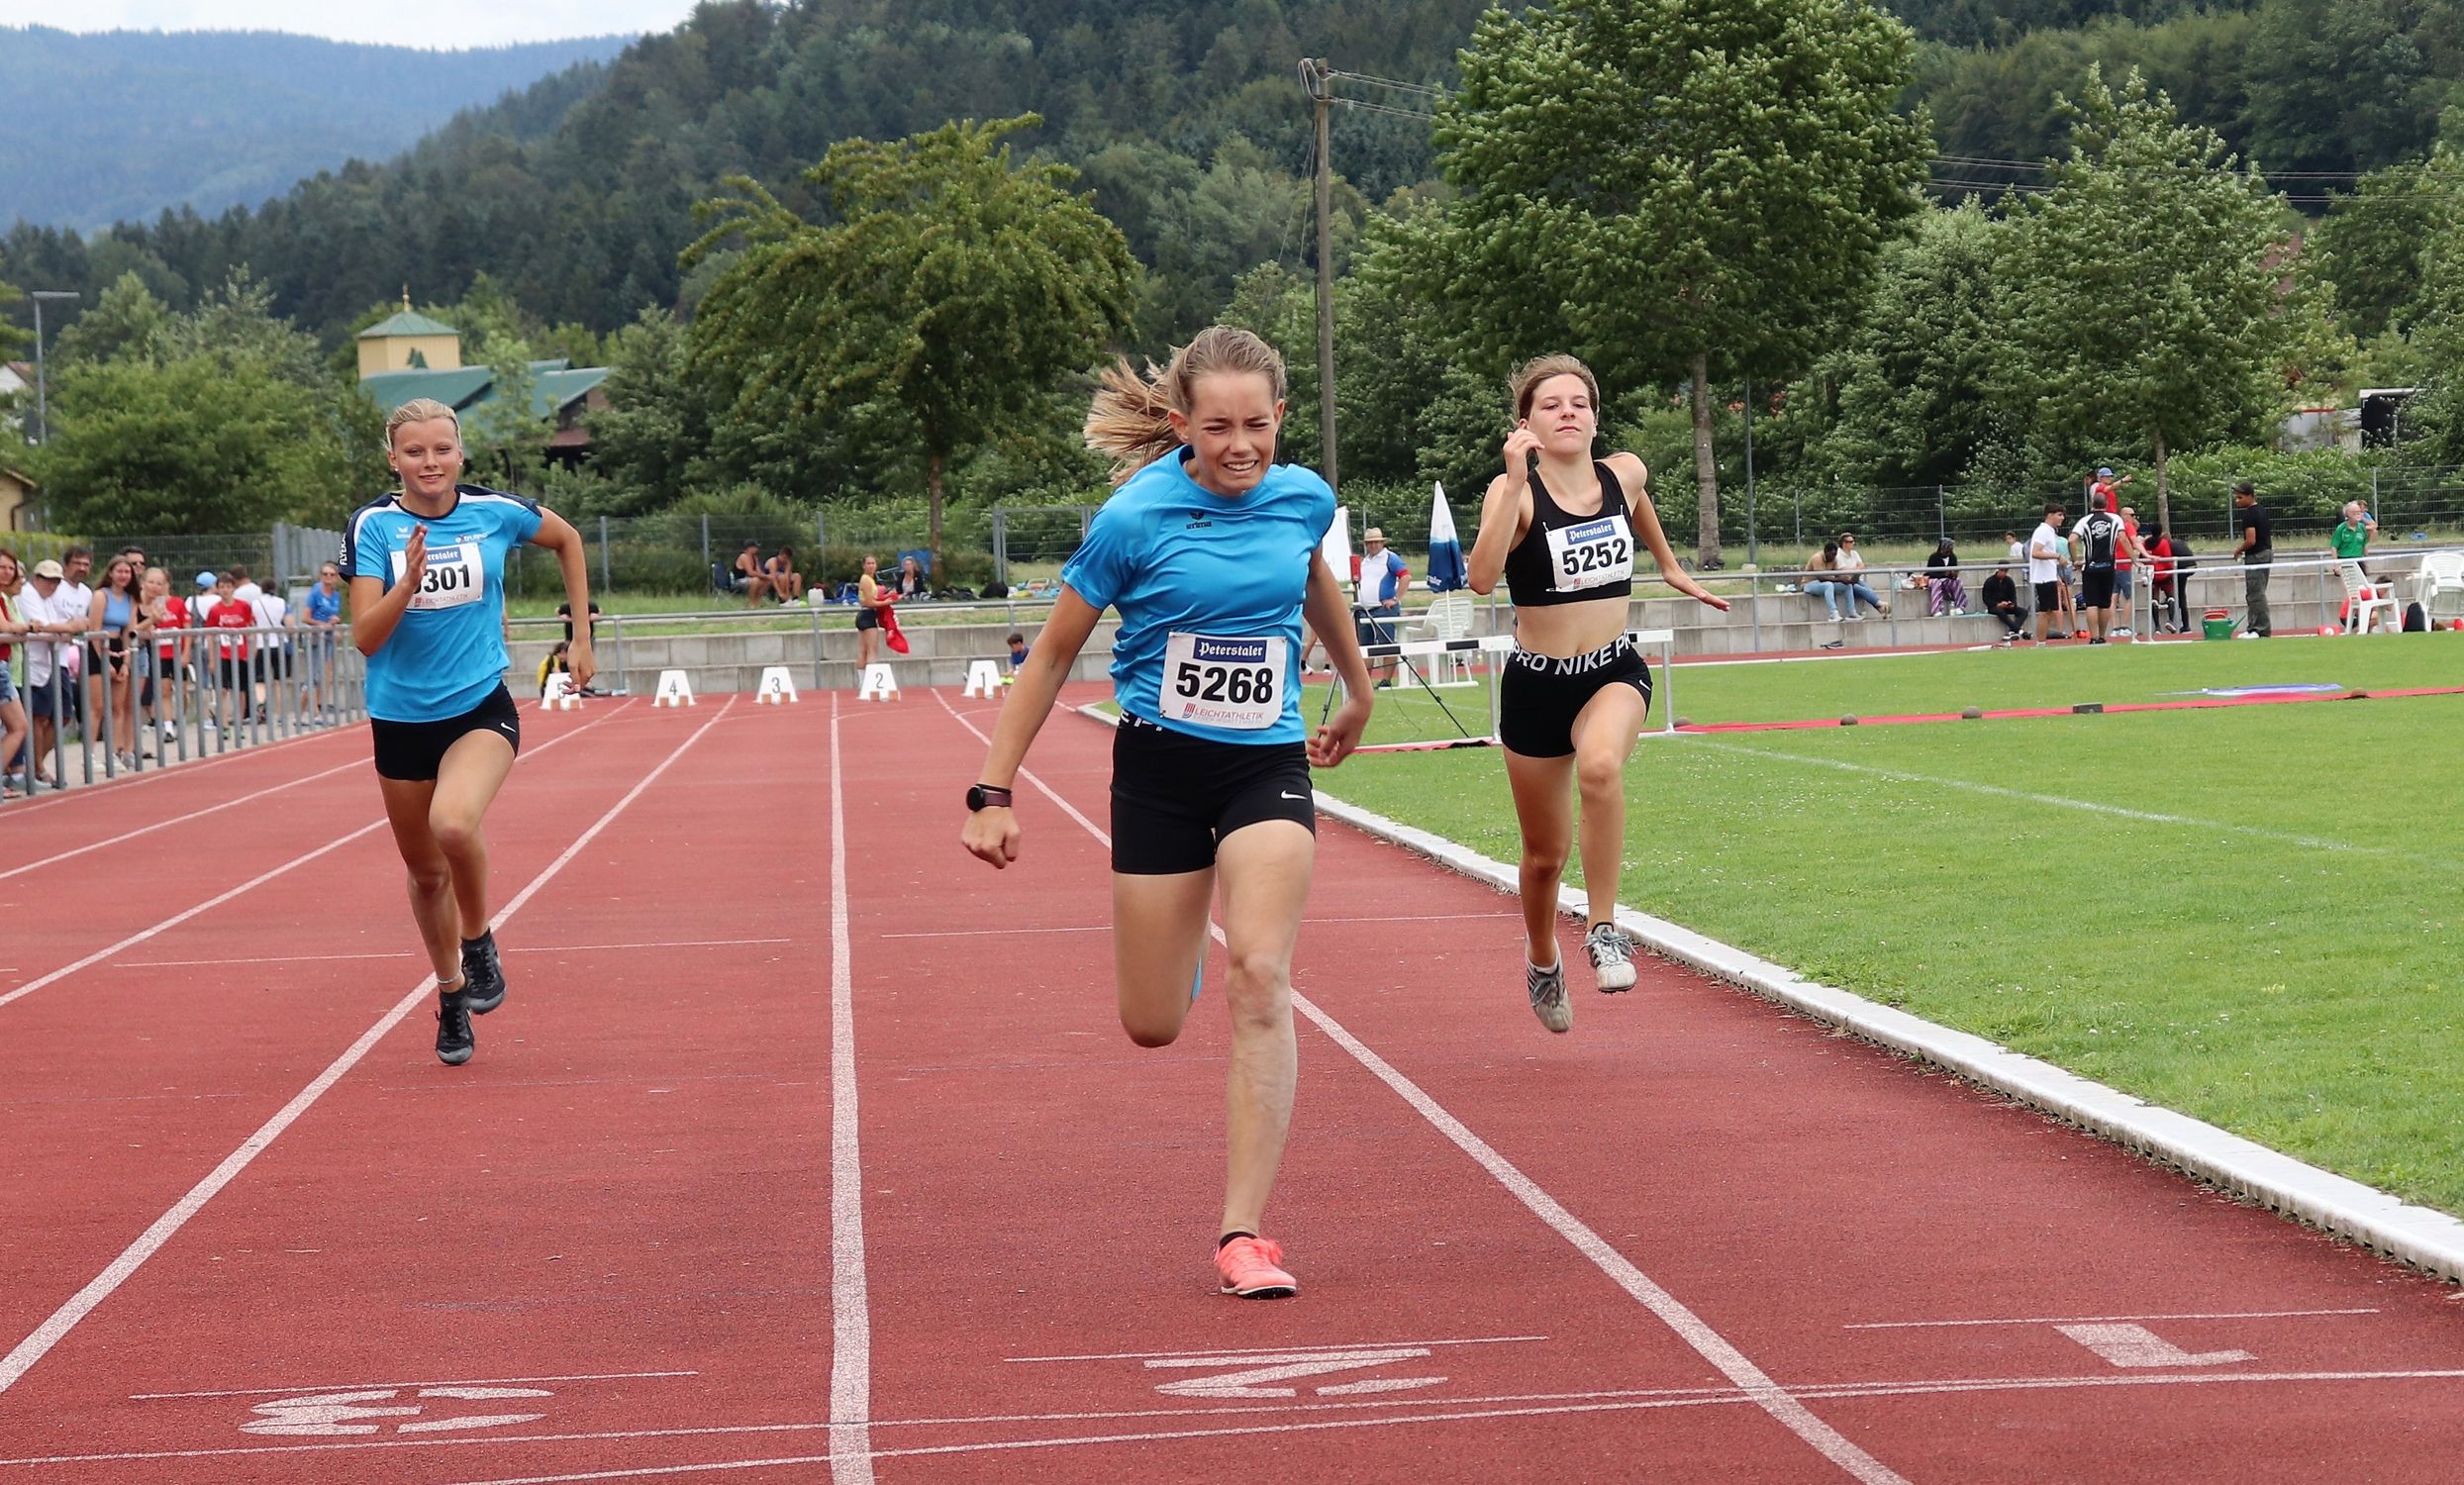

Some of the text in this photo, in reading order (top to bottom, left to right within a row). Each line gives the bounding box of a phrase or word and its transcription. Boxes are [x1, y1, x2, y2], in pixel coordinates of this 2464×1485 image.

[1569, 524, 1613, 542] Peterstaler
[1561, 538, 1628, 576] 5252
[414, 564, 470, 594] 301
[1199, 642, 1263, 657] Peterstaler
[1511, 640, 1548, 672] PRO
[1553, 644, 1613, 675] NIKE
[668, 679, 678, 696] 4
[771, 676, 781, 694] 3
[875, 672, 884, 689] 2
[1175, 661, 1273, 705] 5268
[1195, 707, 1264, 720] LEICHTATHLETIK
[2053, 1323, 2259, 1368] 1
[1142, 1347, 1449, 1399] 2
[238, 1386, 554, 1436] 3
